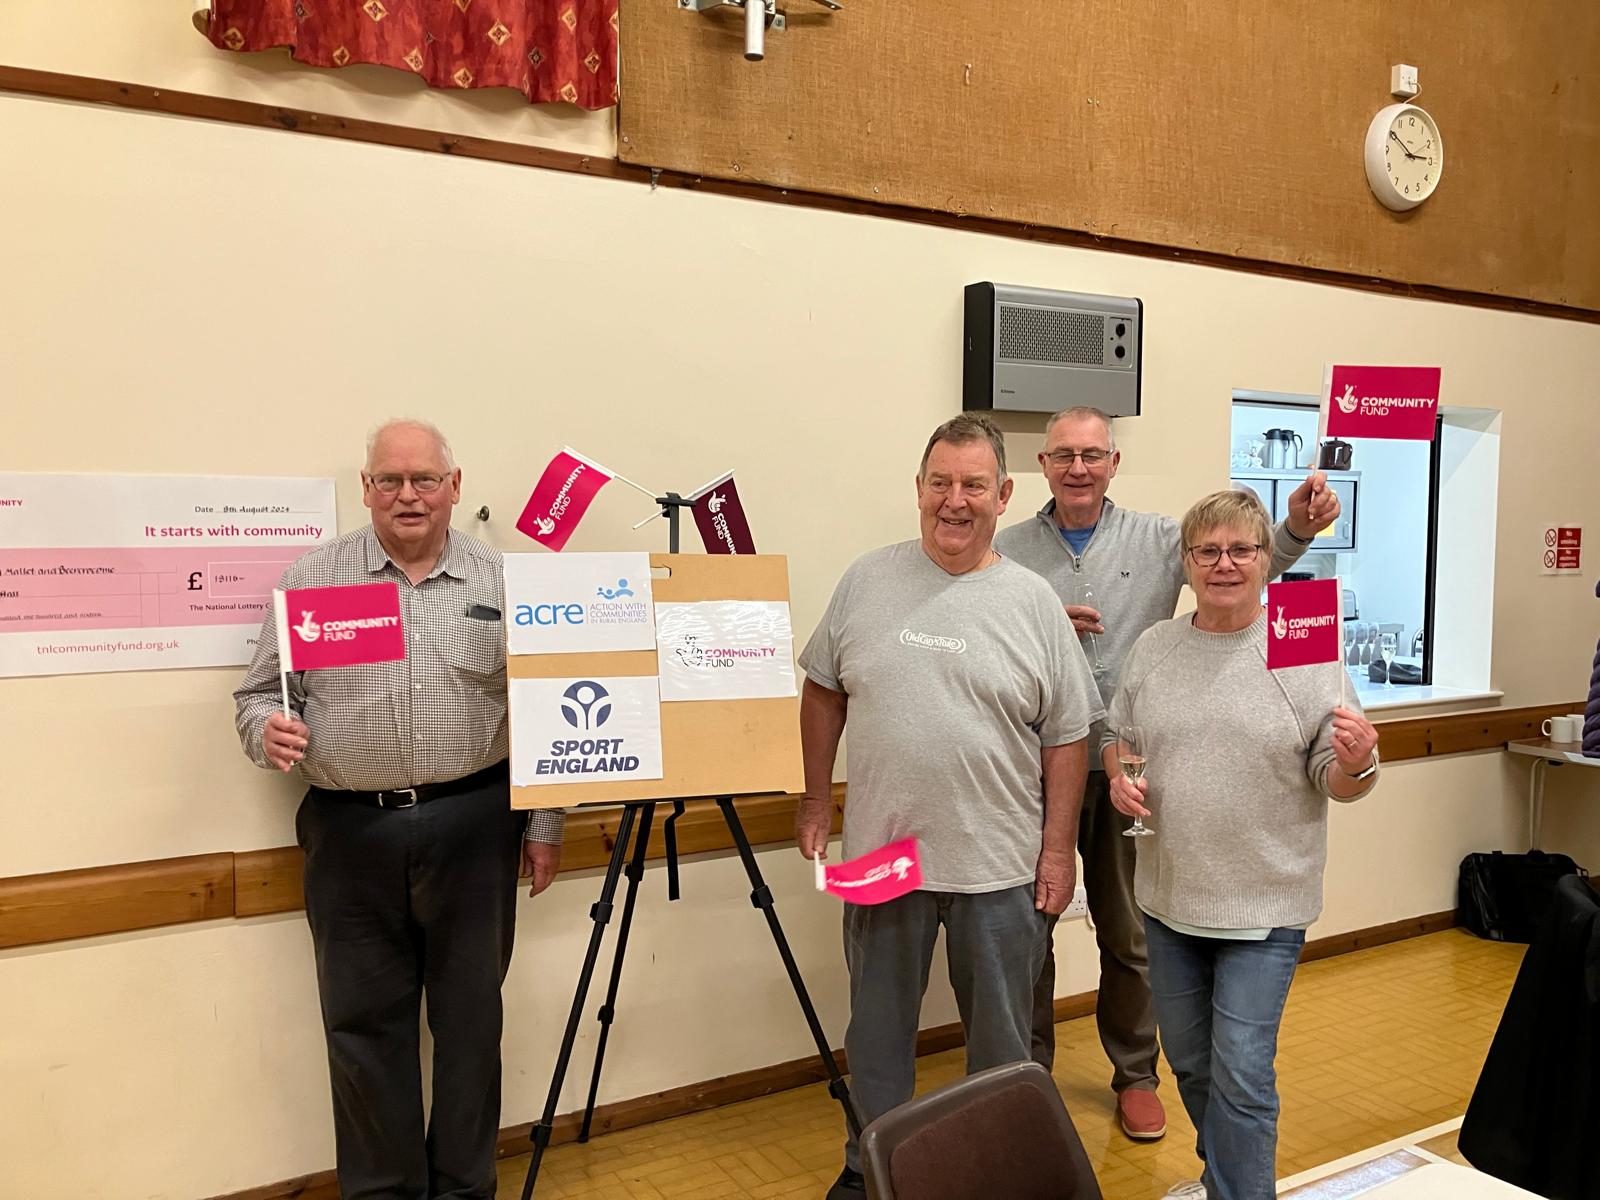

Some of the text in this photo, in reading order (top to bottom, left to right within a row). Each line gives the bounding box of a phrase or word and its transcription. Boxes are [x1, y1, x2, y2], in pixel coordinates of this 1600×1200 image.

[1398, 120, 1402, 128] 11
[1409, 117, 1415, 127] 12
[1426, 139, 1431, 149] 2
[1394, 177, 1399, 185] 7
[1404, 185, 1409, 193] 6
[1416, 183, 1420, 191] 5
[1361, 397, 1434, 408] COMMUNITY
[1360, 407, 1389, 415] FUND
[549, 464, 586, 517] COMMUNITY
[240, 506, 268, 515] August
[555, 496, 571, 520] FUND
[145, 524, 323, 539] It starts with community
[712, 516, 724, 540] FUND
[6, 568, 34, 576] Mallet
[187, 571, 203, 591] £
[238, 603, 264, 612] Lottery
[515, 603, 584, 626] acre
[590, 610, 647, 618] COMMUNITIES
[323, 616, 398, 631] COMMUNITY
[1289, 615, 1335, 628] COMMUNITY
[324, 630, 356, 641] FUND
[1289, 629, 1309, 639] FUND
[37, 640, 179, 654] tnlcommunityfund.org.uk
[705, 648, 776, 657] COMMUNITY
[705, 659, 735, 667] FUND
[551, 739, 624, 756] SPORT
[536, 756, 640, 775] ENGLAND
